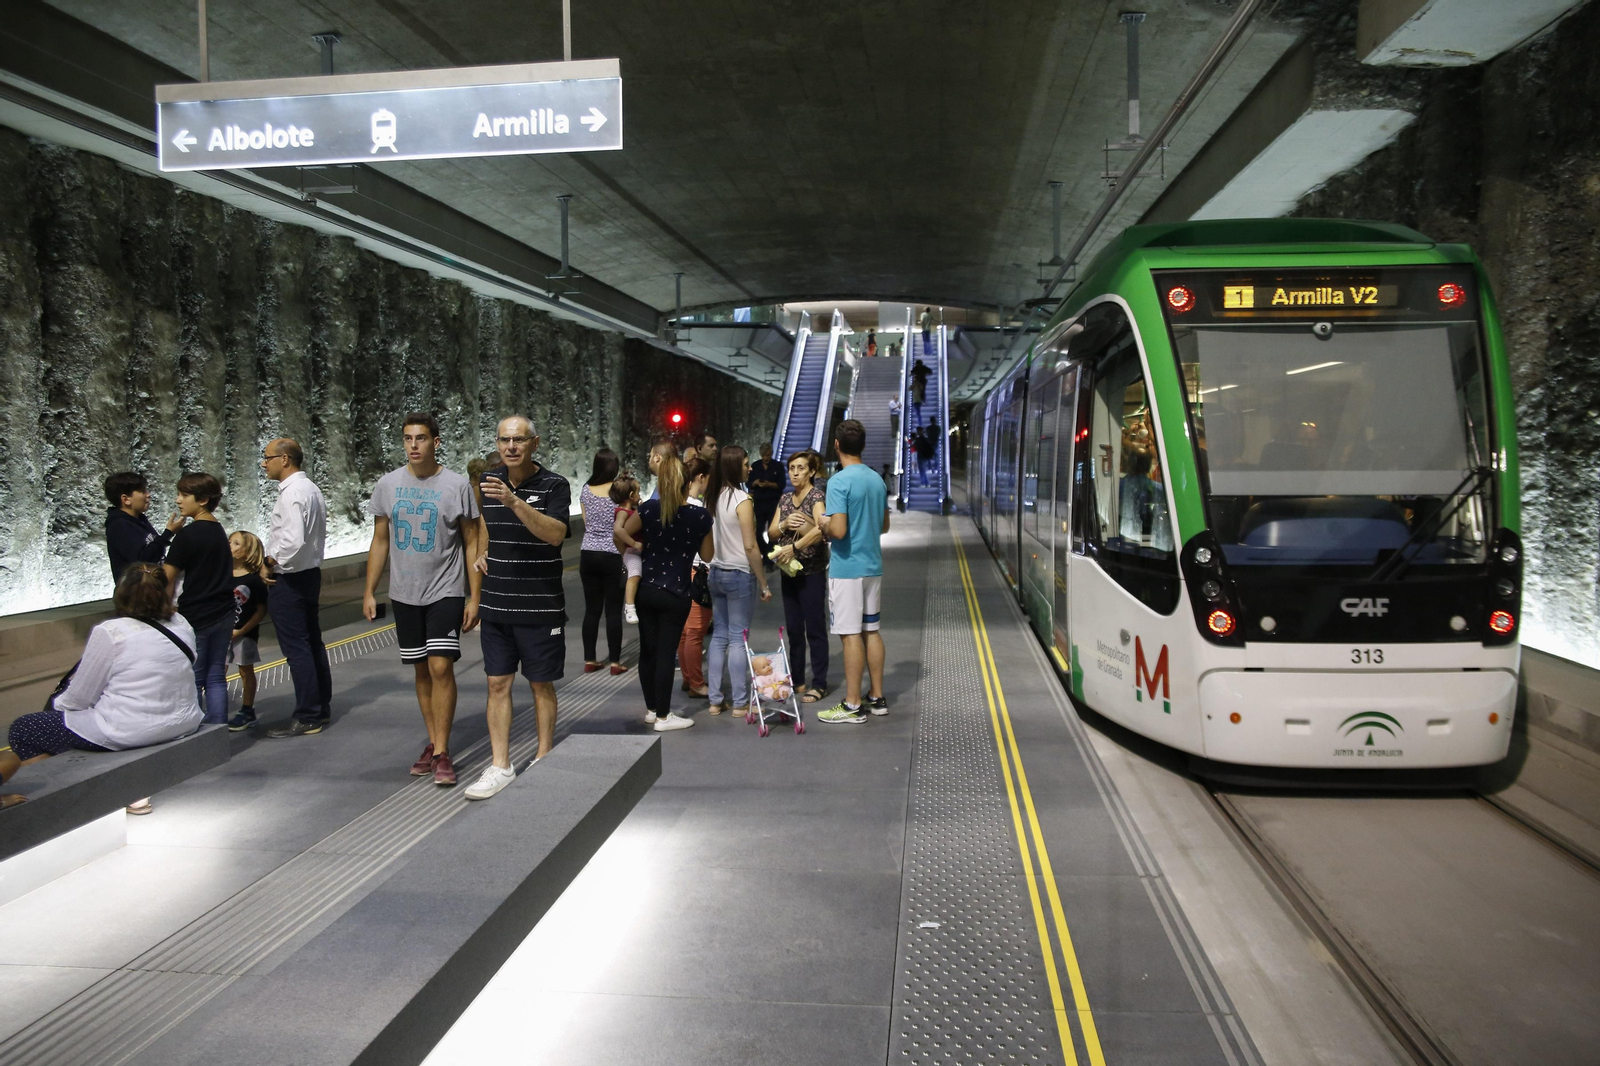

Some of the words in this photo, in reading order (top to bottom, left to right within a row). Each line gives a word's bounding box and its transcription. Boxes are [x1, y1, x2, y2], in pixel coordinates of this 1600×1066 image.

[472, 108, 570, 139] Armilla
[207, 124, 315, 152] Albolote
[1272, 288, 1344, 305] Armilla
[1349, 287, 1378, 304] V2
[395, 487, 441, 501] HARLEM
[392, 500, 438, 552] 63
[1340, 598, 1390, 617] CAF
[1351, 649, 1384, 664] 313
